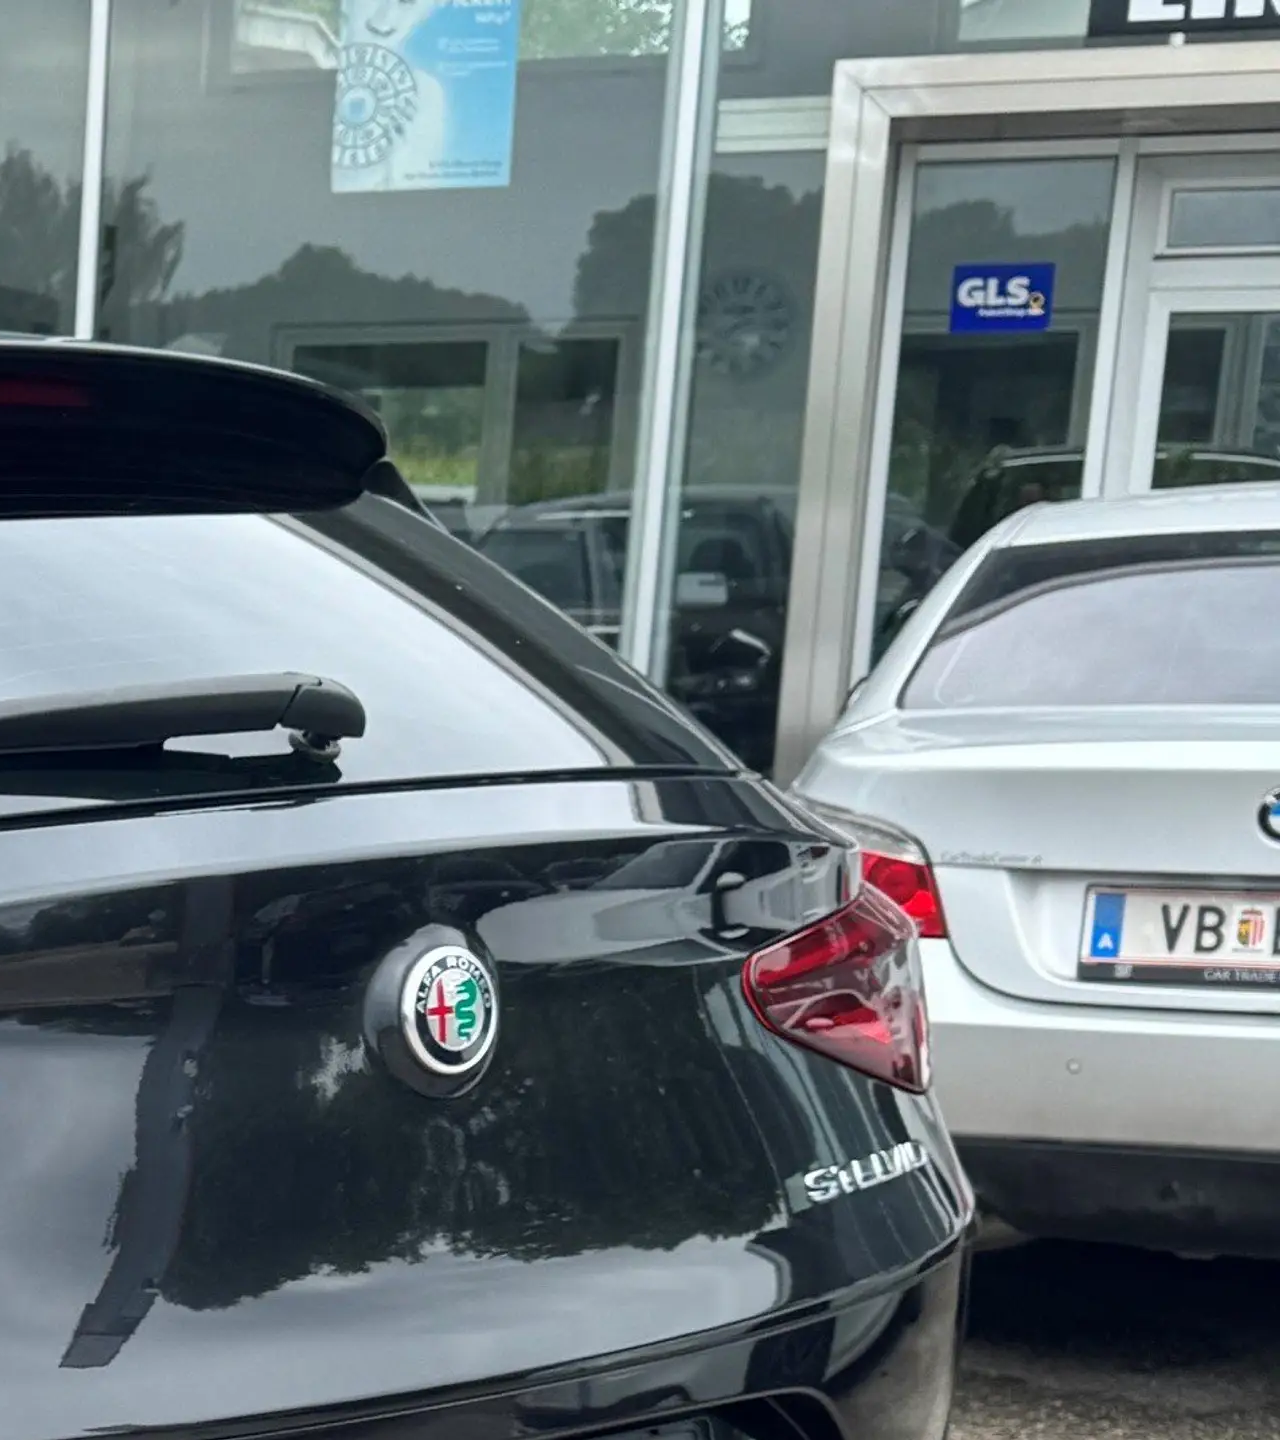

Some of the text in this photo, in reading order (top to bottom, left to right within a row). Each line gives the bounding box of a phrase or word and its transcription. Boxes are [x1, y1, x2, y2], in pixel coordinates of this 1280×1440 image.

[957, 276, 1031, 308] GLS
[1096, 904, 1228, 954] A VB
[416, 956, 491, 1014] ALFA ROMEO
